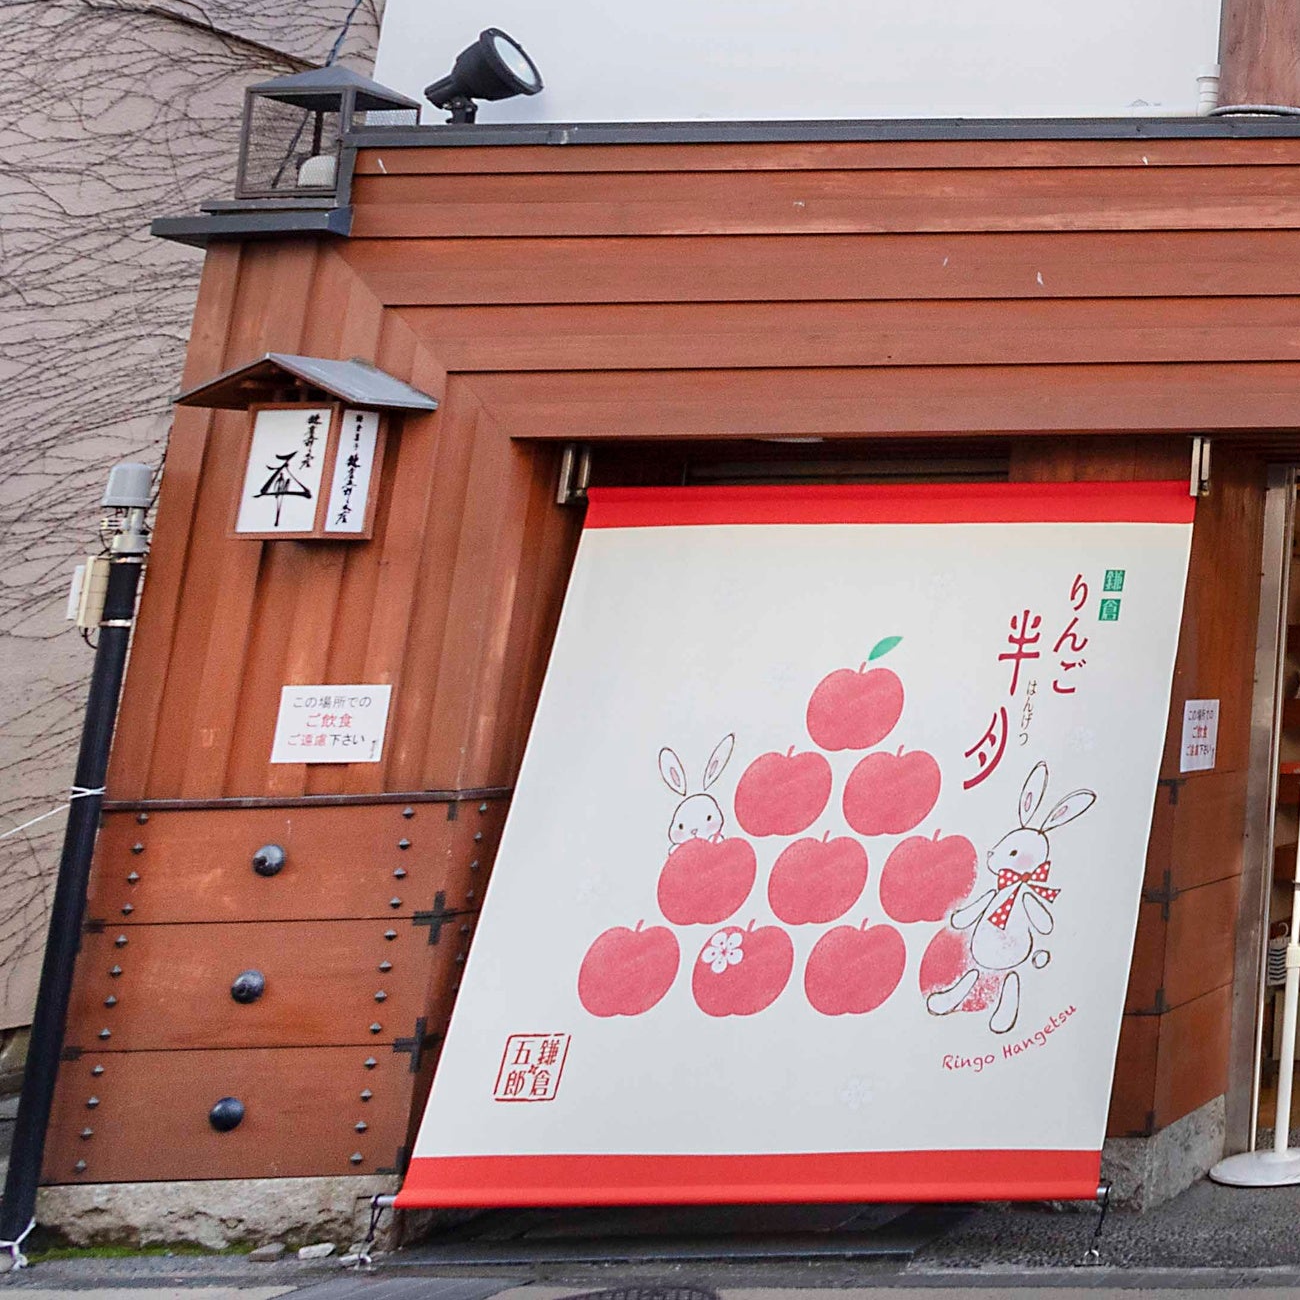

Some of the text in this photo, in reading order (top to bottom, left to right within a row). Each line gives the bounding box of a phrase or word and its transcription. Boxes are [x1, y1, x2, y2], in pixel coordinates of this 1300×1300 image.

[1099, 569, 1126, 621] 鎌倉
[1052, 573, 1088, 694] りんご
[293, 696, 372, 708] この場所での
[306, 713, 353, 728] ご飲食
[963, 609, 1042, 790] 半月
[1019, 680, 1038, 746] はんげつ
[287, 734, 366, 746] ご遠慮下さい
[942, 1004, 1077, 1073] Ringo Hangetsu
[503, 1040, 535, 1096] 五郎
[529, 1039, 560, 1097] 鎌倉
